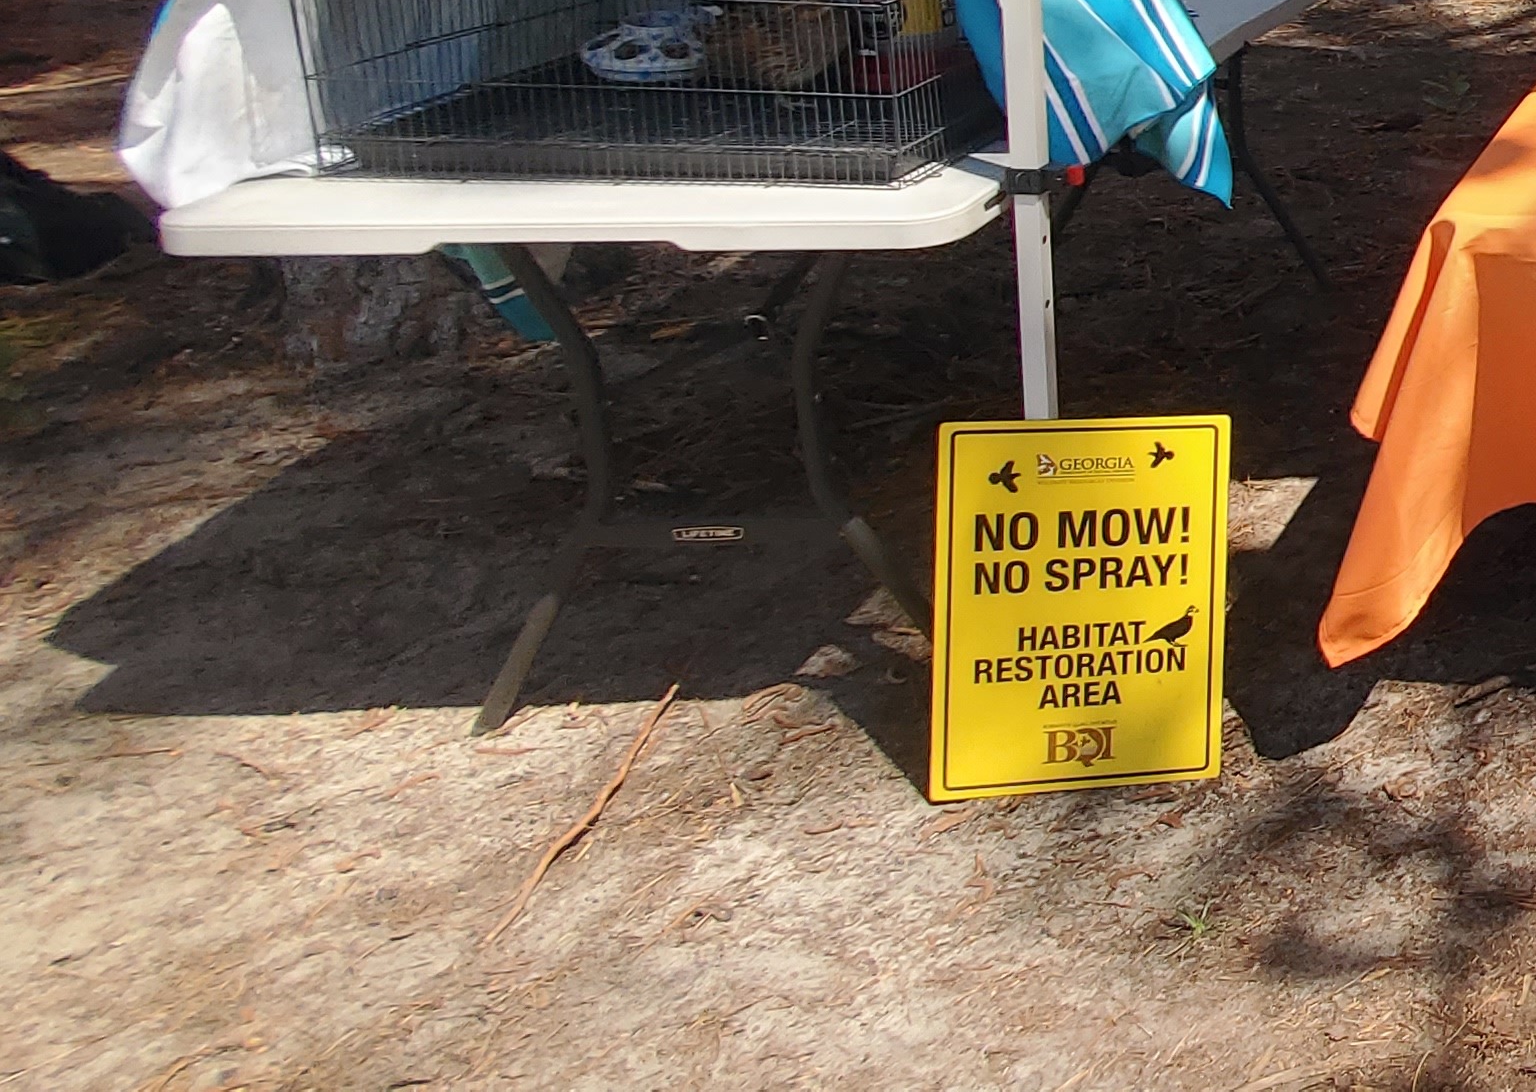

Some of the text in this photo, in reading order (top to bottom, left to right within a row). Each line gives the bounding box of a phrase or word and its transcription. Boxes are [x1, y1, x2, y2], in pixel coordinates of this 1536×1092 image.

[1059, 457, 1135, 471] GEORGIA
[973, 505, 1191, 553] NO MOW!
[973, 553, 1190, 595] NO SPRAY!
[1017, 620, 1147, 652] HABITAT
[973, 646, 1187, 684] RESTORATION
[1038, 681, 1122, 710] AREA
[1041, 726, 1117, 768] BQI
